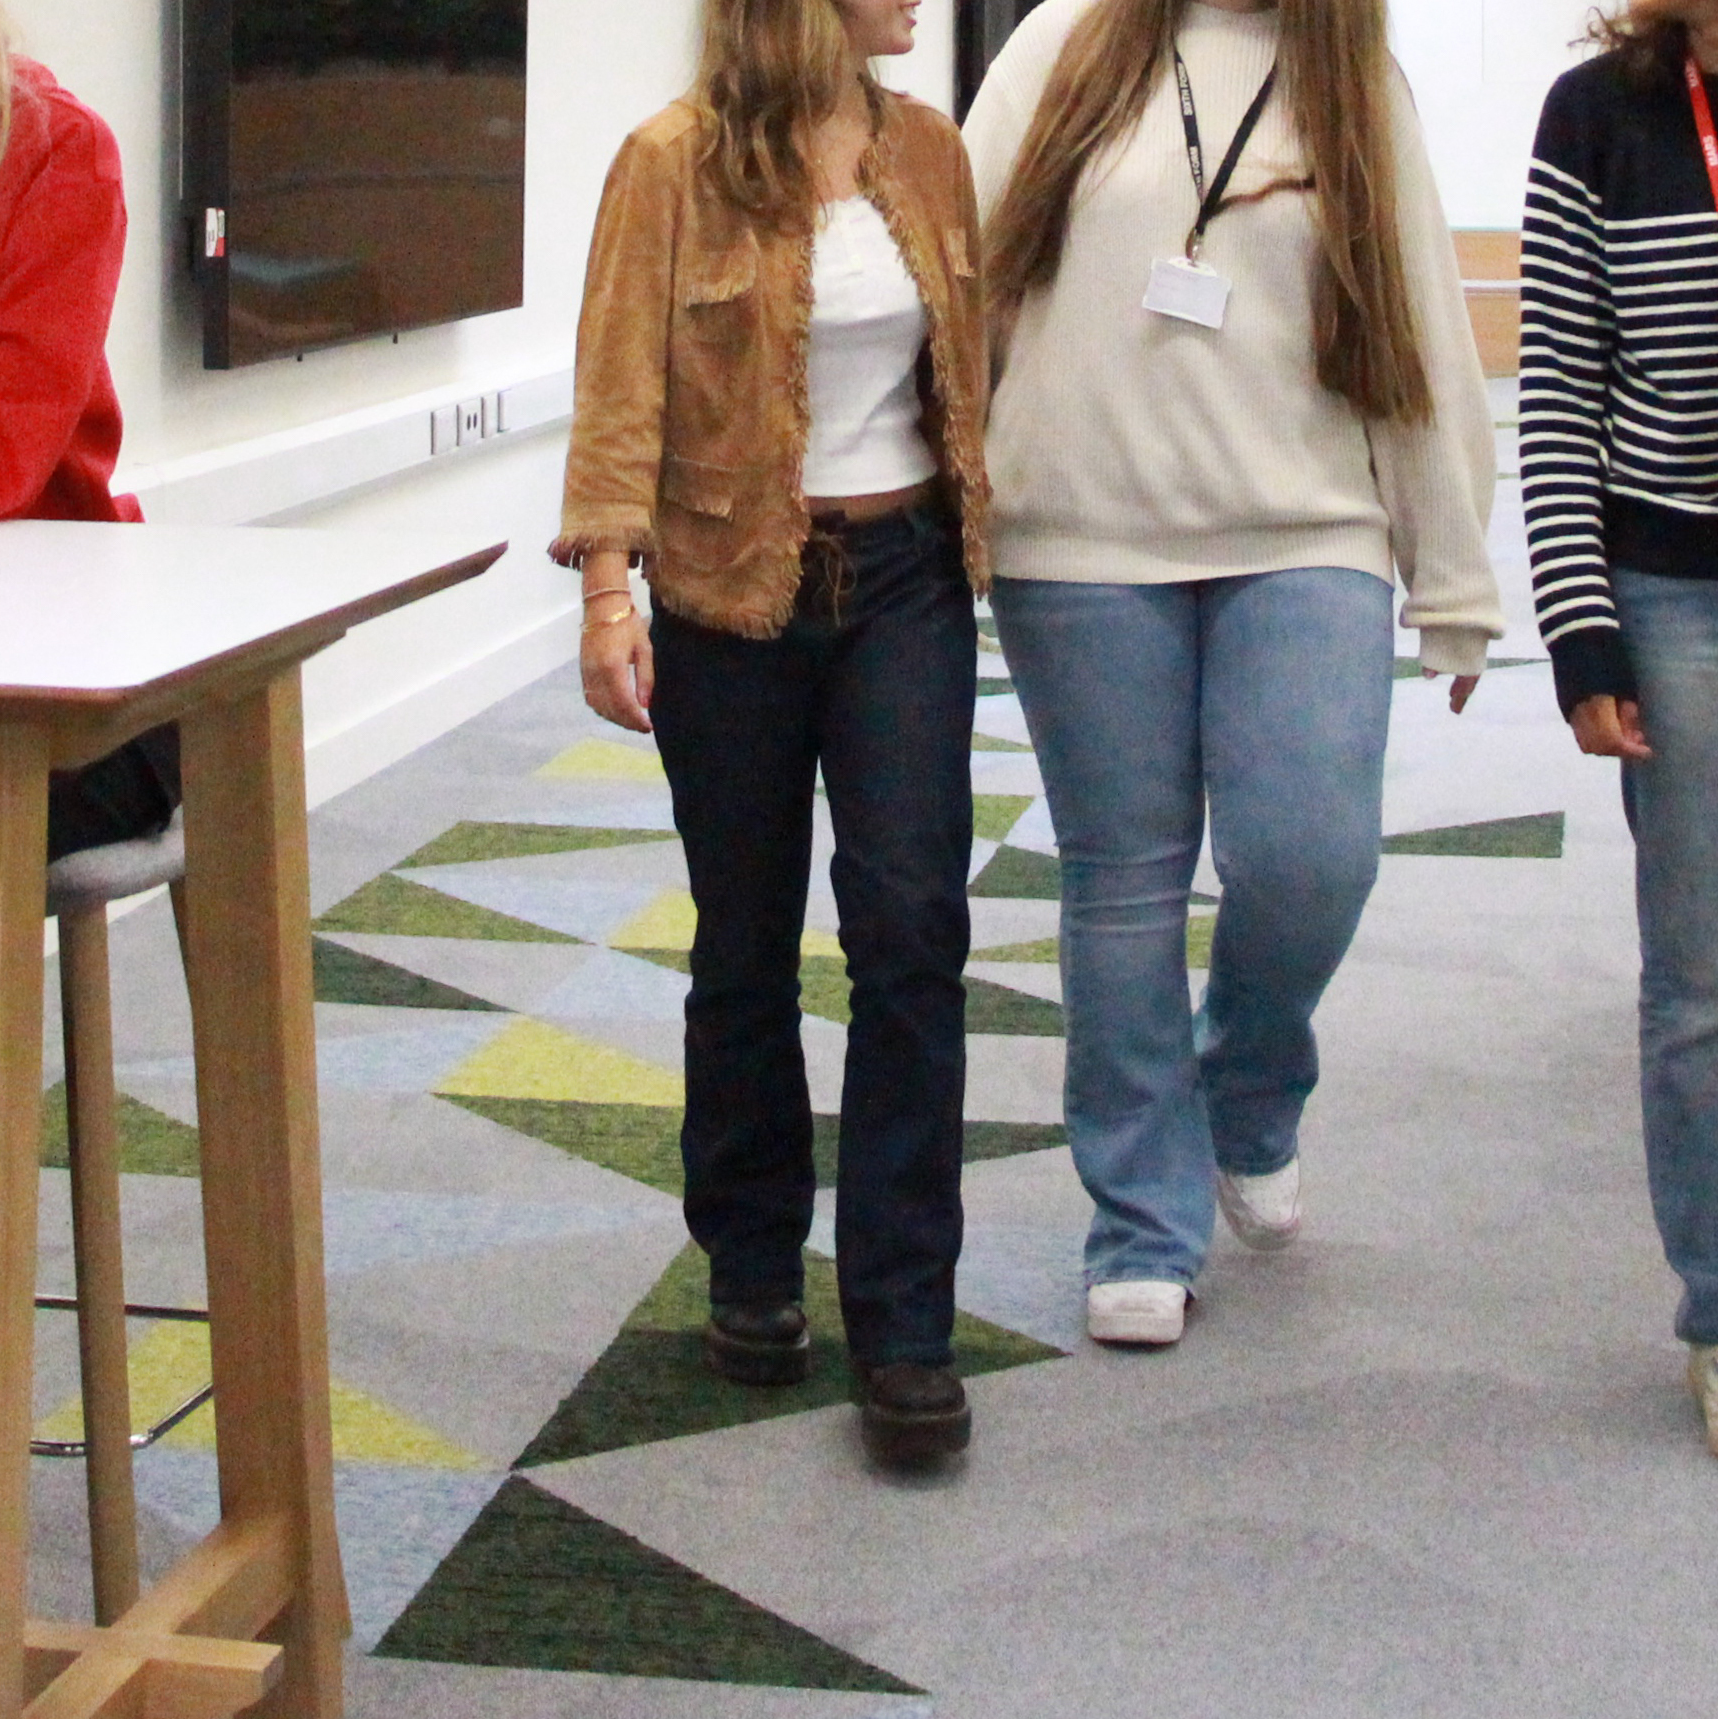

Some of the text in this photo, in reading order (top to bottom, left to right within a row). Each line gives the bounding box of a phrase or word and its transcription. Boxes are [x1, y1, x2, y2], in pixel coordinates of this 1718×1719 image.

[1181, 89, 1193, 116] SIXTH
[1189, 146, 1201, 175] FORM
[1703, 135, 1718, 166] MARS
